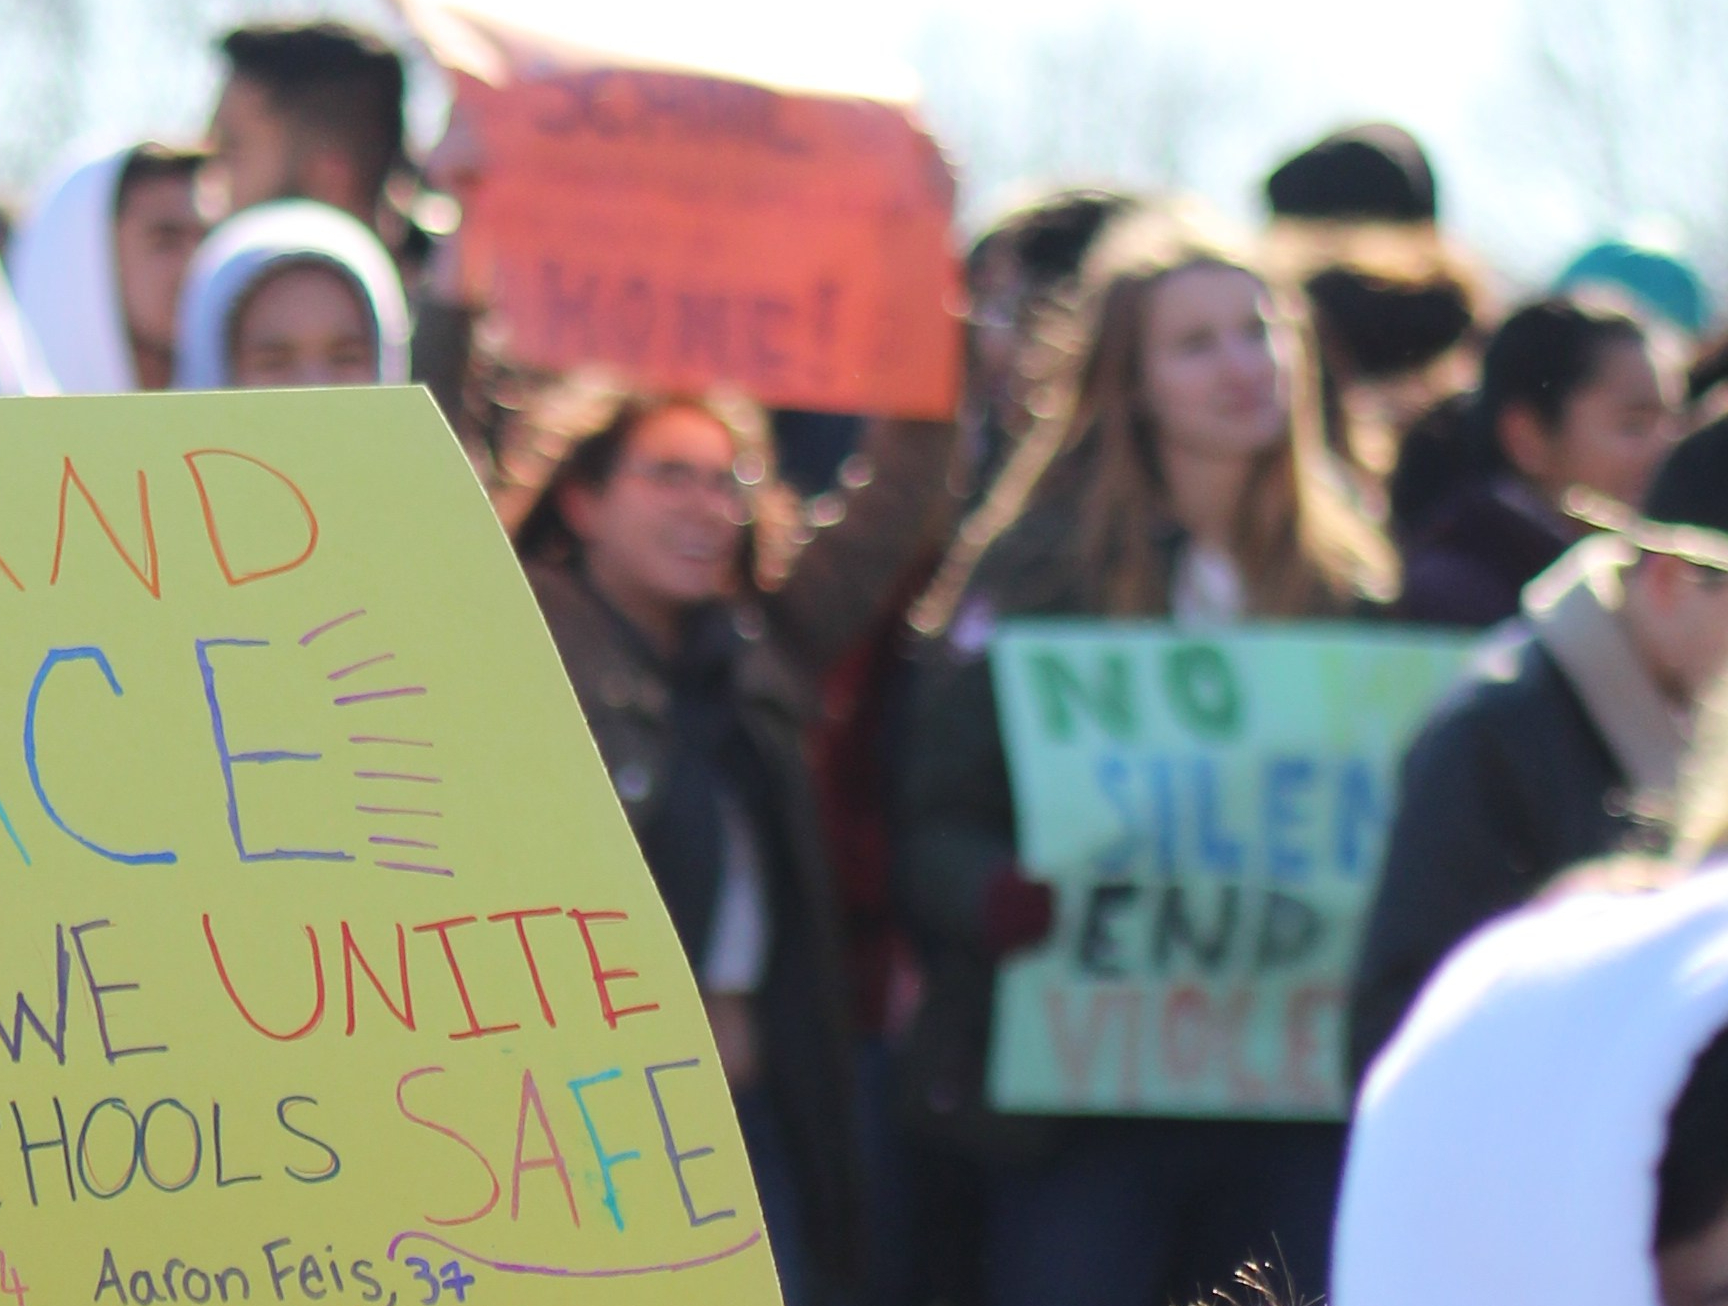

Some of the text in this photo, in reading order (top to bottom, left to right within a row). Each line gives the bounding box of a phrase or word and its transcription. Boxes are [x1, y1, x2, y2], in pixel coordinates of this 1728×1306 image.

[1027, 643, 1244, 742] NO
[202, 907, 661, 1042] UNITE
[1075, 882, 1322, 980] END
[396, 1058, 736, 1232] SAFE
[94, 1248, 251, 1306] Aaron
[405, 1256, 475, 1302] 37
